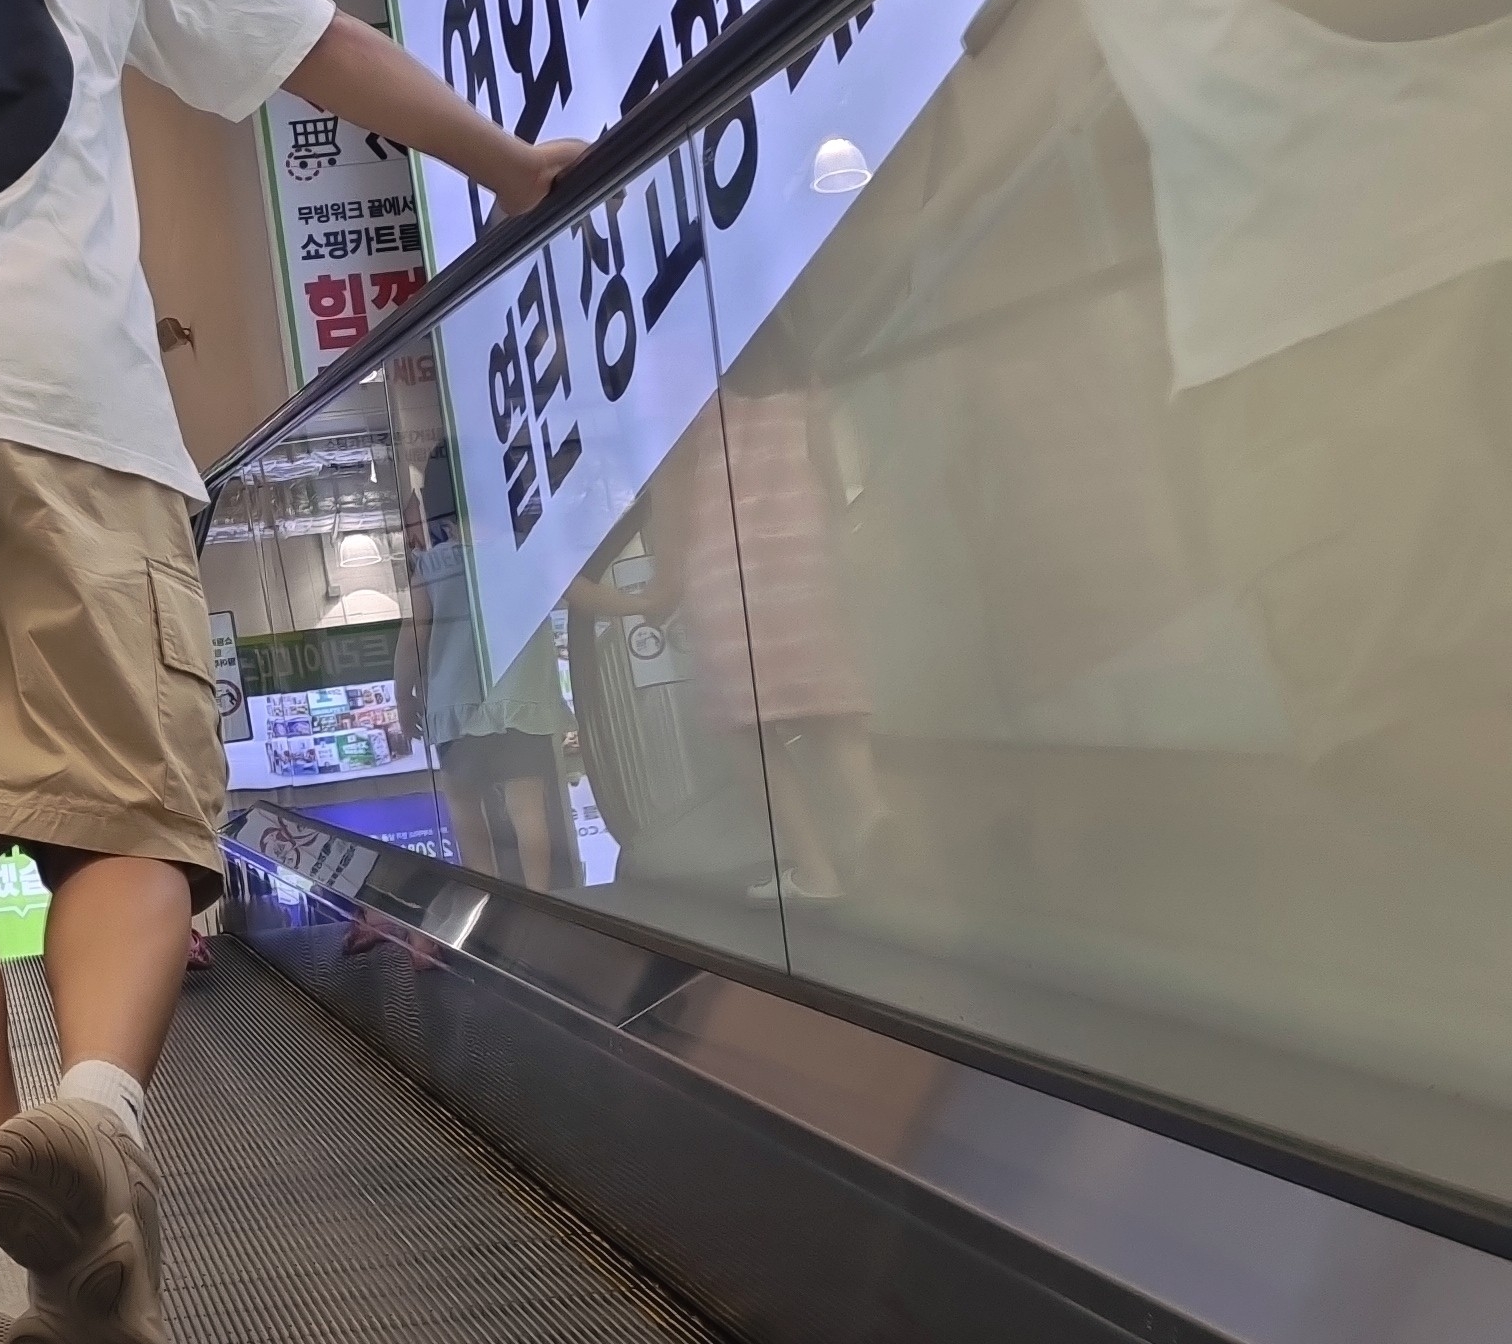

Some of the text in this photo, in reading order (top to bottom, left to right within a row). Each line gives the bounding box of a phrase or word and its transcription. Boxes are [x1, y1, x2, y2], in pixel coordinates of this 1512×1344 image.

[297, 195, 418, 225] 무빙워크 끝에서
[300, 223, 422, 261] 쇼핑카트를
[488, 244, 583, 551] 열린
